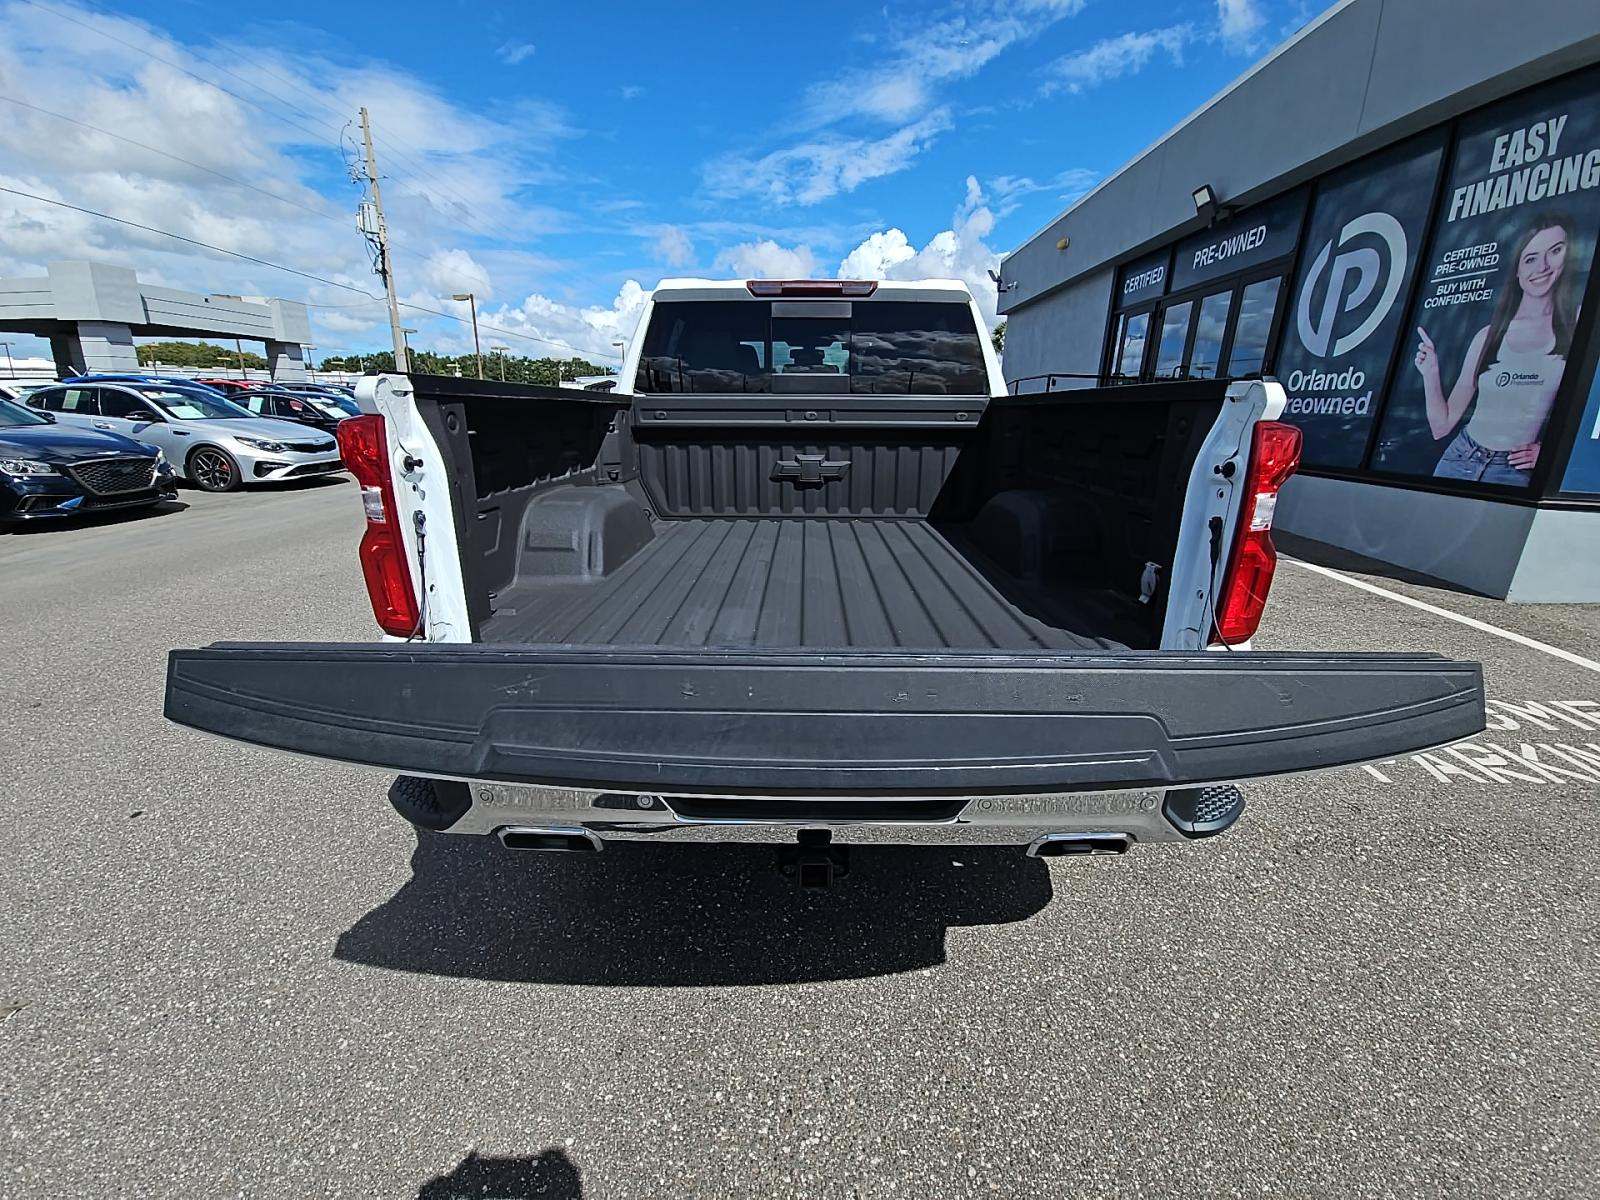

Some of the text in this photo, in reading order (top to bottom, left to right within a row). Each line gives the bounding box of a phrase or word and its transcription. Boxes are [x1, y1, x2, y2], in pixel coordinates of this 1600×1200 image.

[1489, 114, 1568, 174] EASY
[1447, 149, 1600, 223] FINANCING
[1124, 225, 1266, 294] CERTIFIED PRE-OWNED
[1444, 242, 1497, 262] CERTIFIED
[1435, 255, 1499, 276] PRE-OWNED
[1437, 277, 1486, 296] BUY WITH
[1424, 290, 1493, 309] CONFIDENCE!
[1288, 366, 1364, 391] Orlando
[1284, 391, 1372, 415] reowned
